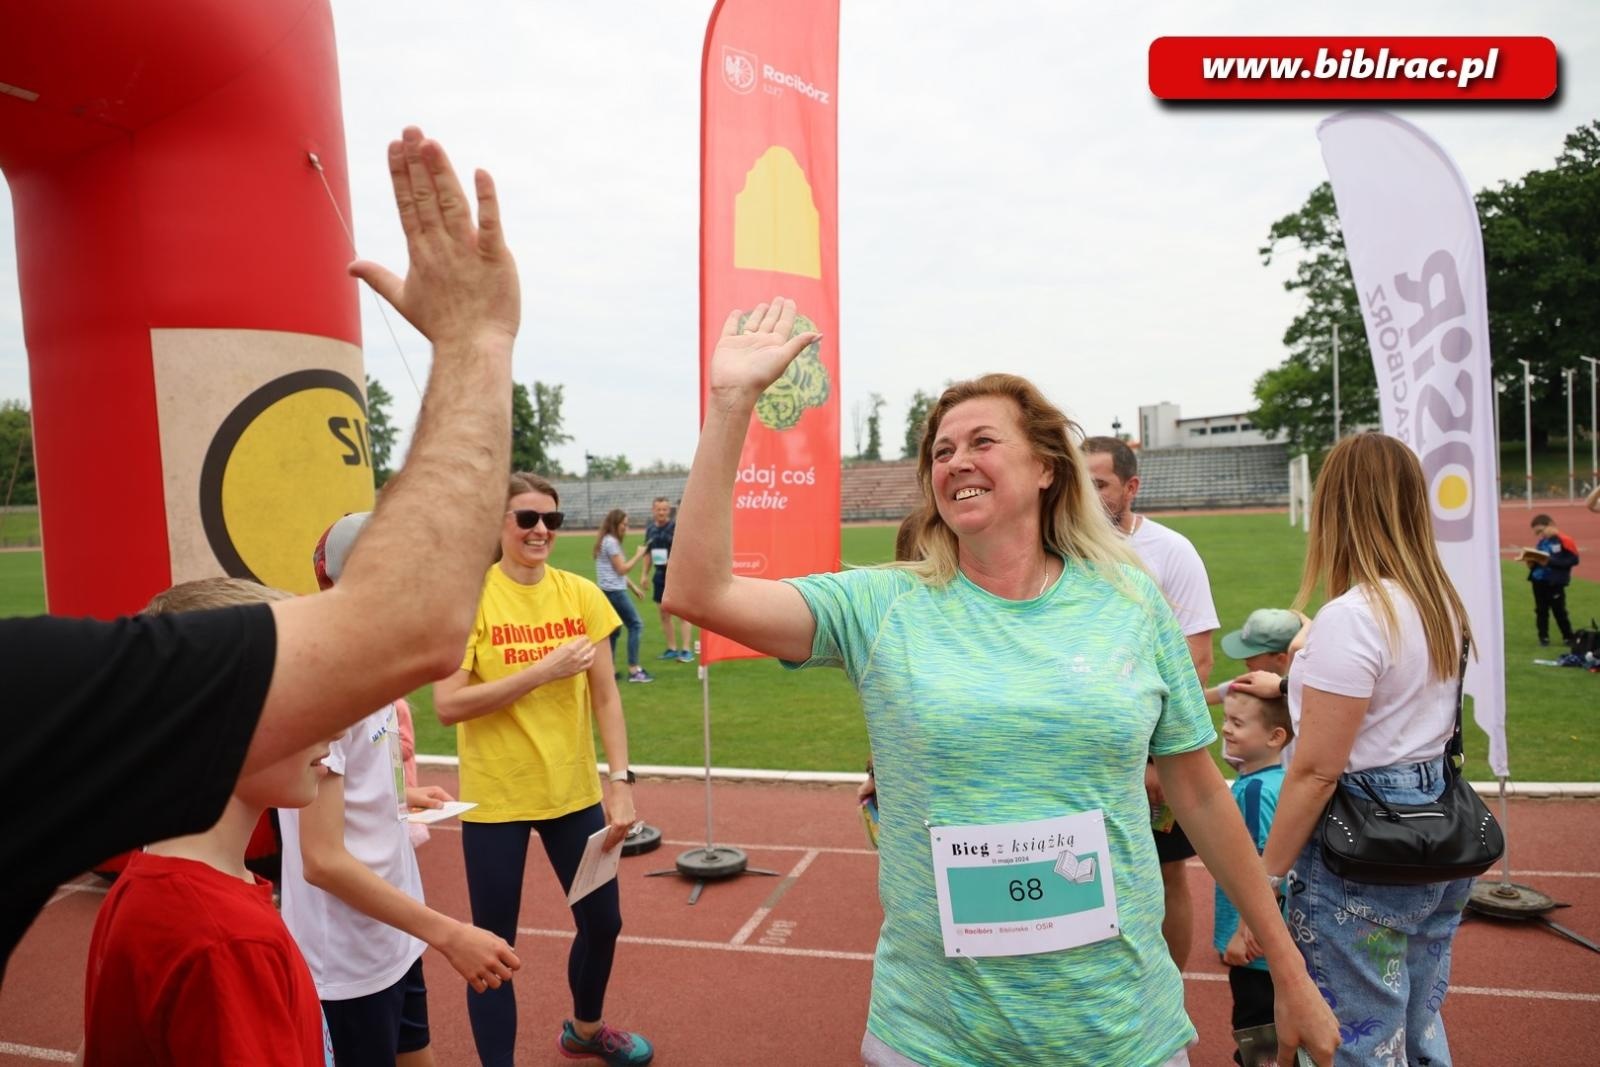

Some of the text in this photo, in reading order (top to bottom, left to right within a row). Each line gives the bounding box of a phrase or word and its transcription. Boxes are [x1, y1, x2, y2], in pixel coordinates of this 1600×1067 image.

[762, 63, 829, 105] Racibórz
[327, 416, 369, 468] SI
[781, 466, 816, 485] coś
[735, 490, 788, 510] siebie
[491, 617, 586, 646] Biblioteka
[952, 833, 1075, 857] Bieg z książką
[1009, 878, 1043, 902] 68
[1035, 921, 1055, 931] OSiR
